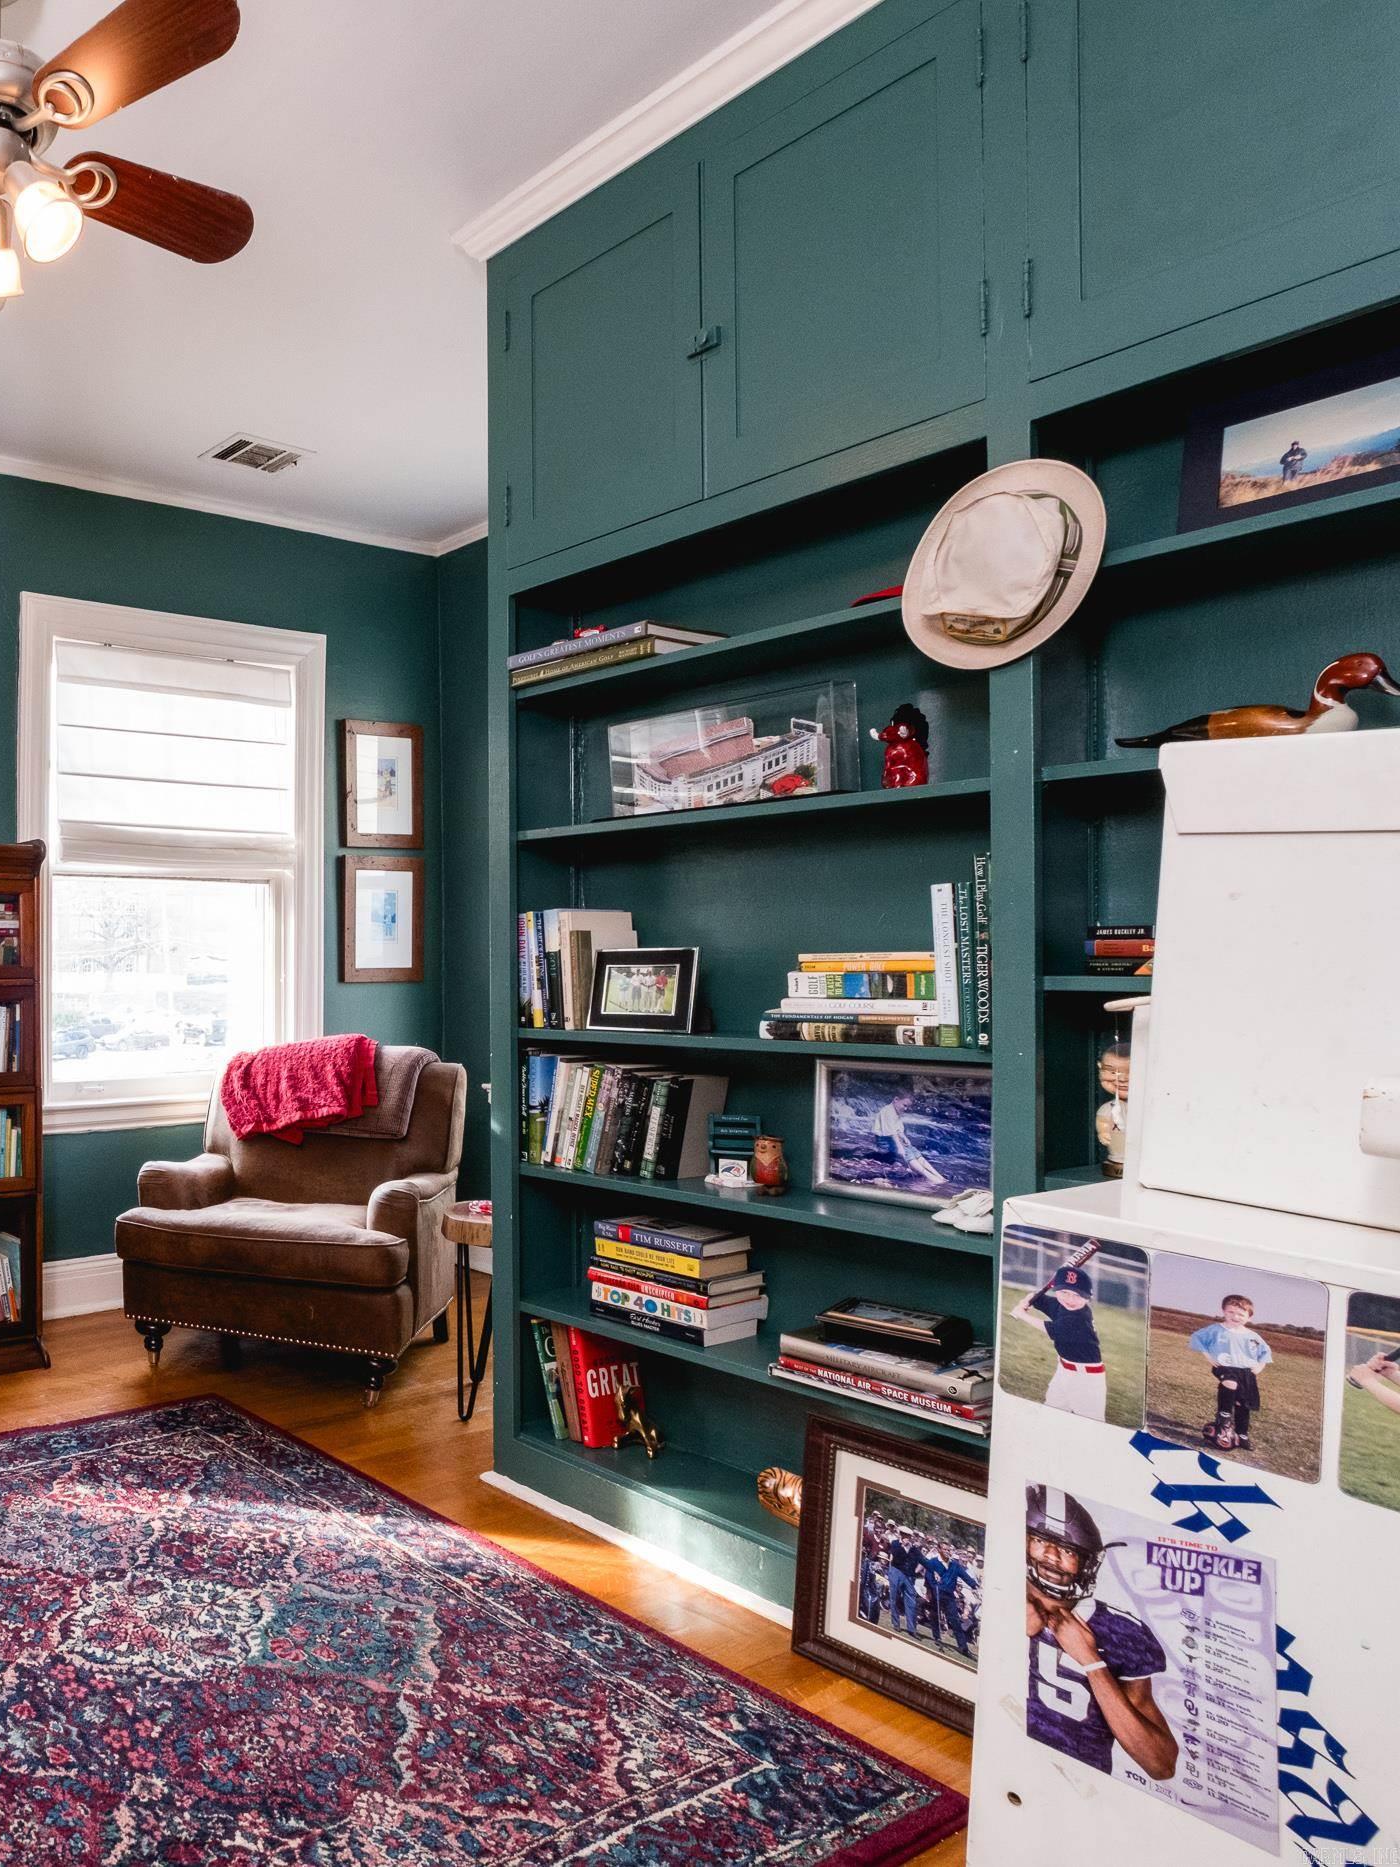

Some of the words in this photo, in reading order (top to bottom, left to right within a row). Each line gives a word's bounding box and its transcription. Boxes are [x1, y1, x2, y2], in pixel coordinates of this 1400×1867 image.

[518, 653, 543, 664] GOLF'S
[544, 641, 583, 657] GREATEST
[584, 630, 626, 647] MOMENTS
[976, 857, 987, 877] How
[940, 902, 949, 919] THE
[959, 906, 969, 934] LOST
[976, 903, 988, 925] Golf
[518, 917, 526, 937] JOHN
[942, 921, 951, 959] LONGEST
[1096, 928, 1113, 936] JAMES
[518, 939, 526, 960] DALY
[960, 935, 971, 984] MASTERS
[977, 944, 989, 977] TIGER
[808, 975, 819, 995] GOLF
[977, 977, 990, 1023] WOODS
[587, 1069, 601, 1097] SUPER
[583, 1096, 595, 1119] MEX
[633, 1233, 651, 1244] TIM
[654, 1237, 695, 1253] RUSSERT
[602, 1287, 630, 1306] TOP
[633, 1296, 658, 1313] 40
[661, 1302, 693, 1323] HITS
[586, 1362, 641, 1399] GREAT
[817, 1368, 856, 1387] NATIONAL
[857, 1379, 872, 1391] AIR
[880, 1386, 909, 1401] SPACE
[910, 1394, 953, 1414] MUSEUM
[1157, 1536, 1176, 1545] IT'S
[1179, 1539, 1202, 1549] TIME
[1205, 1543, 1218, 1552] TO
[1152, 1546, 1257, 1582] KNUCKLE
[1165, 1567, 1202, 1594] UP
[1125, 1770, 1147, 1786] TCU
